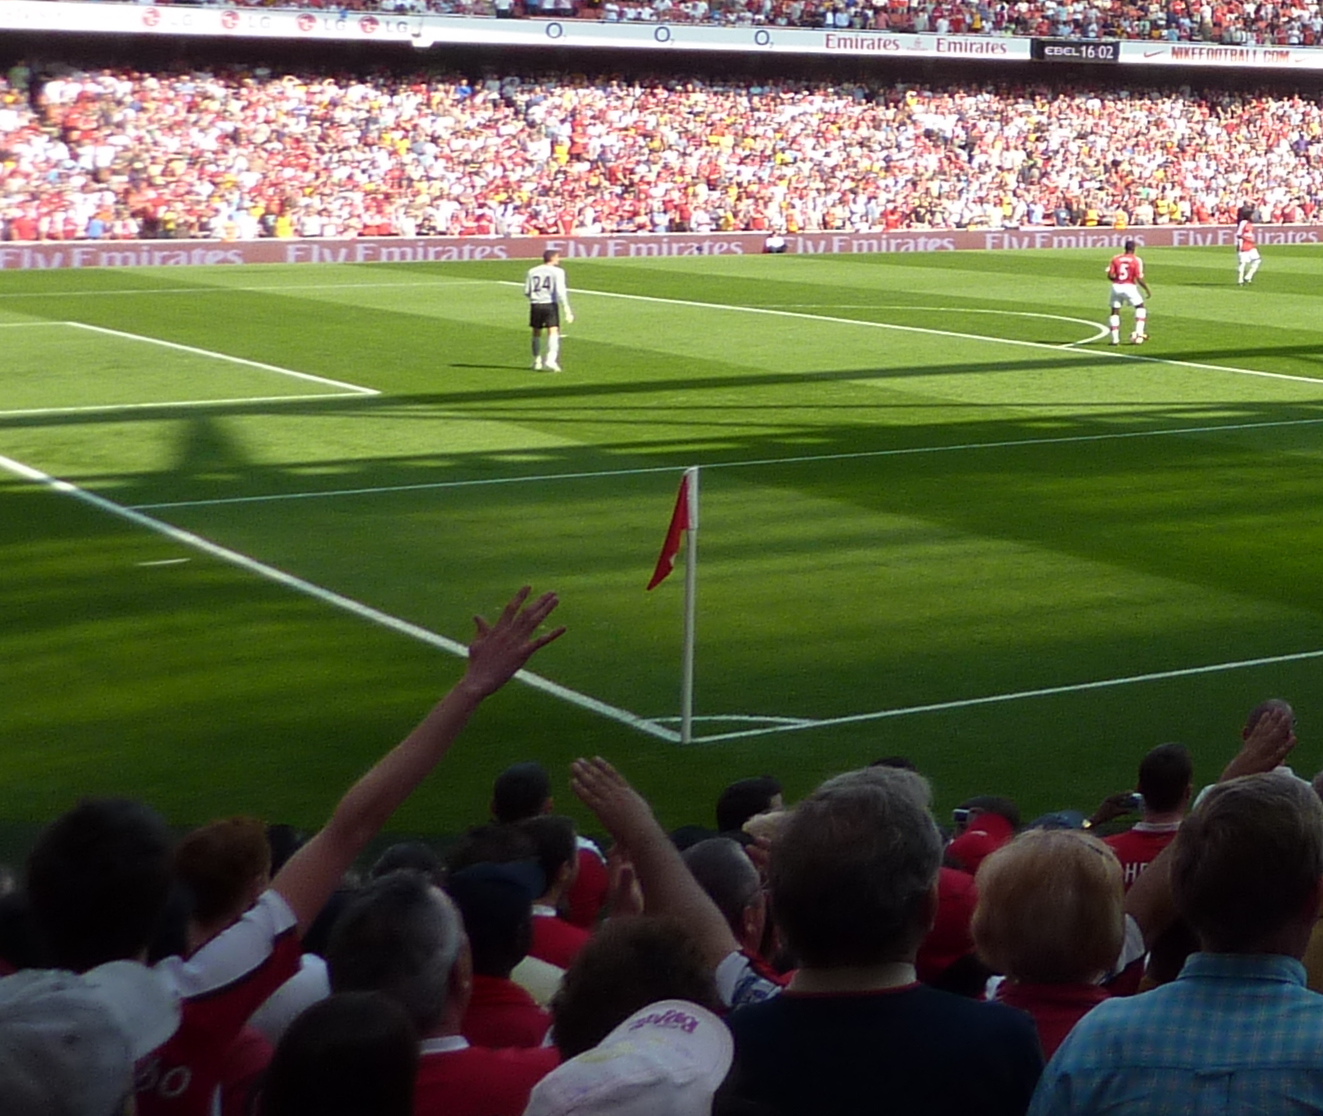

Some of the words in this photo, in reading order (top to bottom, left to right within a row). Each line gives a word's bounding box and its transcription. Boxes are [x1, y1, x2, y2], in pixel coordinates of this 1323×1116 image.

[323, 18, 347, 31] LG
[386, 21, 409, 33] LG
[825, 34, 900, 51] Emirates
[936, 38, 1007, 55] Emirates
[1171, 46, 1290, 64] NIKEFOOTBALL.COM
[832, 235, 955, 254] Emirates
[986, 233, 1029, 250] Fly
[1035, 232, 1145, 249] Emirates
[1172, 230, 1212, 246] Fly
[286, 244, 348, 263] Fly
[356, 243, 507, 262] Emirates
[607, 238, 743, 257] Emirates
[71, 247, 244, 268] Emirates
[1118, 263, 1129, 280] 5
[532, 275, 551, 292] 24
